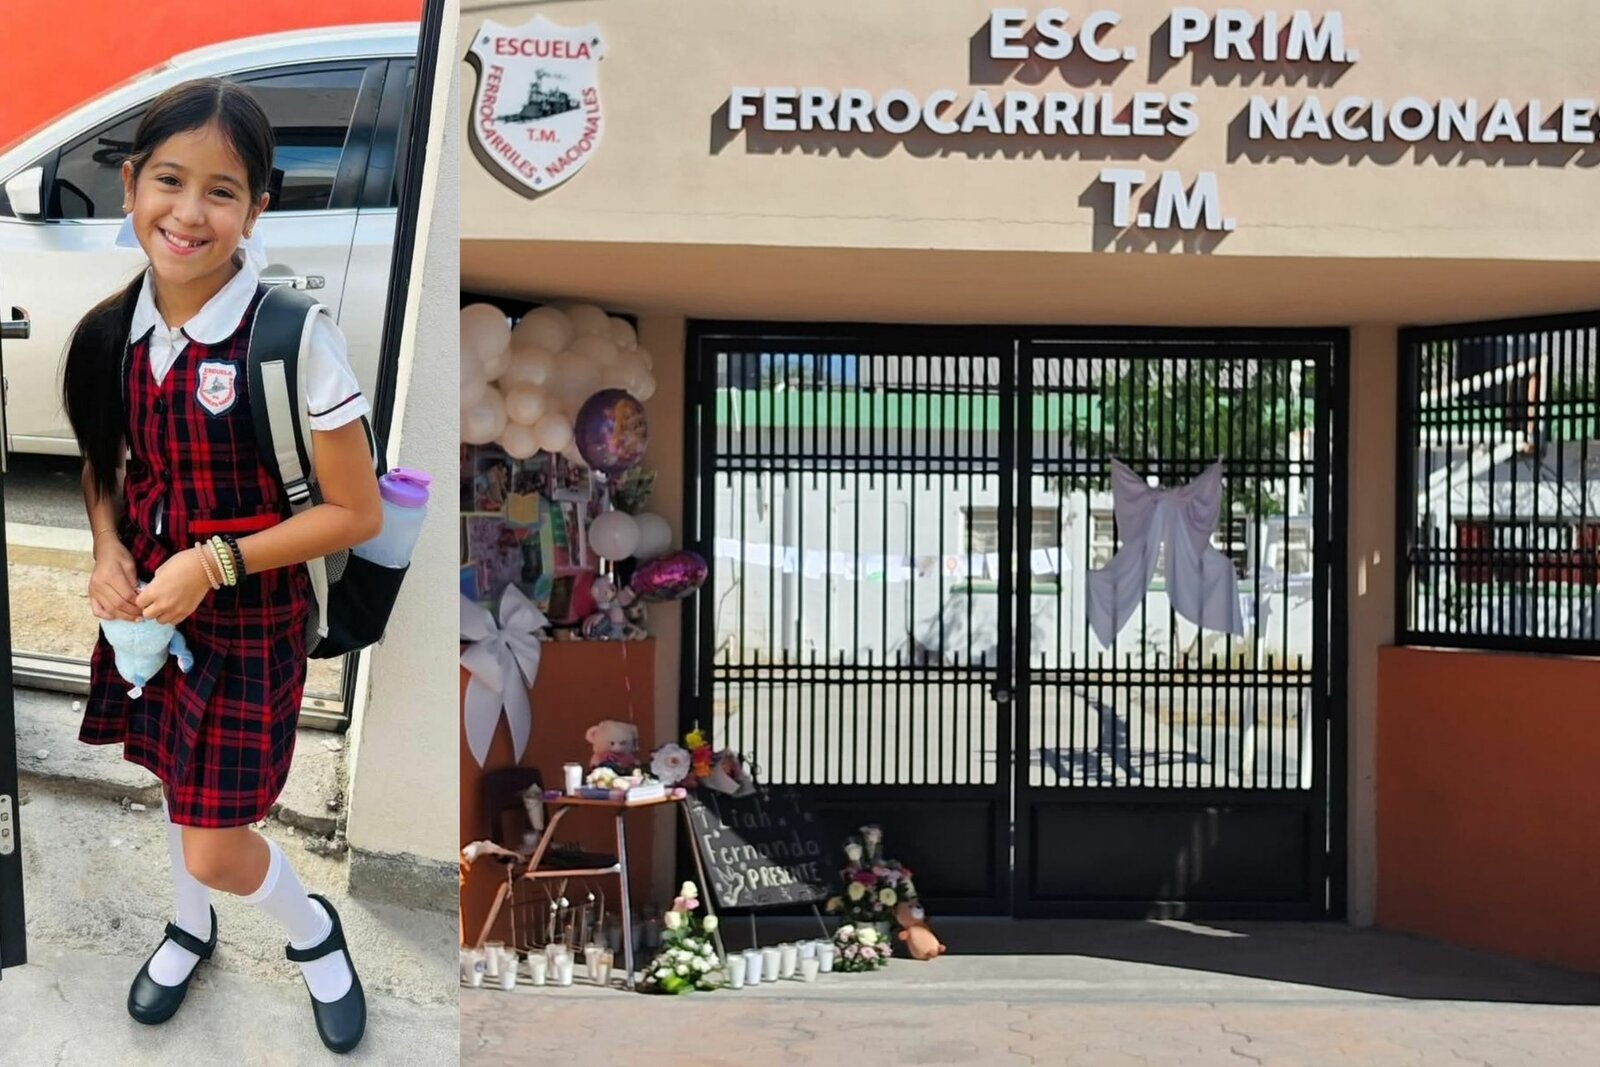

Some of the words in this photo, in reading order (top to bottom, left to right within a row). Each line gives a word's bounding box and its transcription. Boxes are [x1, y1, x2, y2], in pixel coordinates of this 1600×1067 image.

[495, 37, 591, 59] ESCUELA
[990, 8, 1136, 62] ESC.
[1169, 8, 1360, 63] PRIM.
[480, 65, 537, 178] FERROCARRILES
[527, 128, 560, 143] T.M.
[545, 87, 600, 177] NACIONALES
[728, 87, 1199, 137] FERROCARRILES
[1248, 96, 1600, 144] NACIONALE
[1099, 168, 1236, 232] T.M.
[703, 830, 821, 865] Fernanda
[746, 861, 822, 890] PRESENTE
